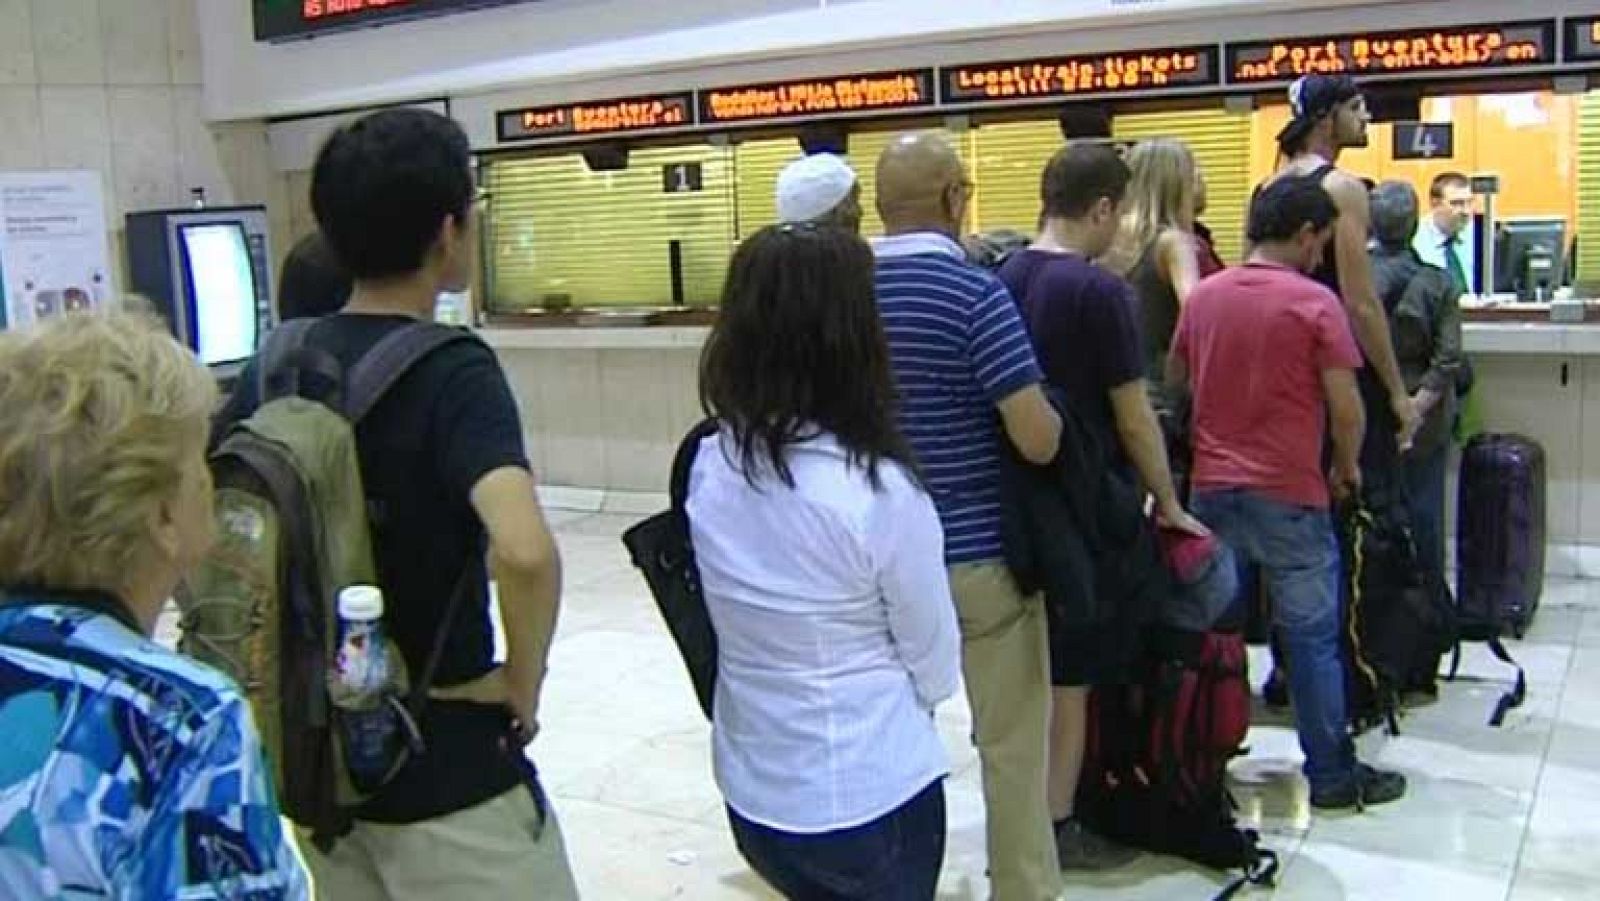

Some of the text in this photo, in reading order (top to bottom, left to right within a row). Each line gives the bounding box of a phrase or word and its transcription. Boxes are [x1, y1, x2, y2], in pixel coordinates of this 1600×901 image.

[1272, 40, 1337, 61] Port
[1411, 126, 1438, 157] 4
[674, 164, 691, 191] 1
